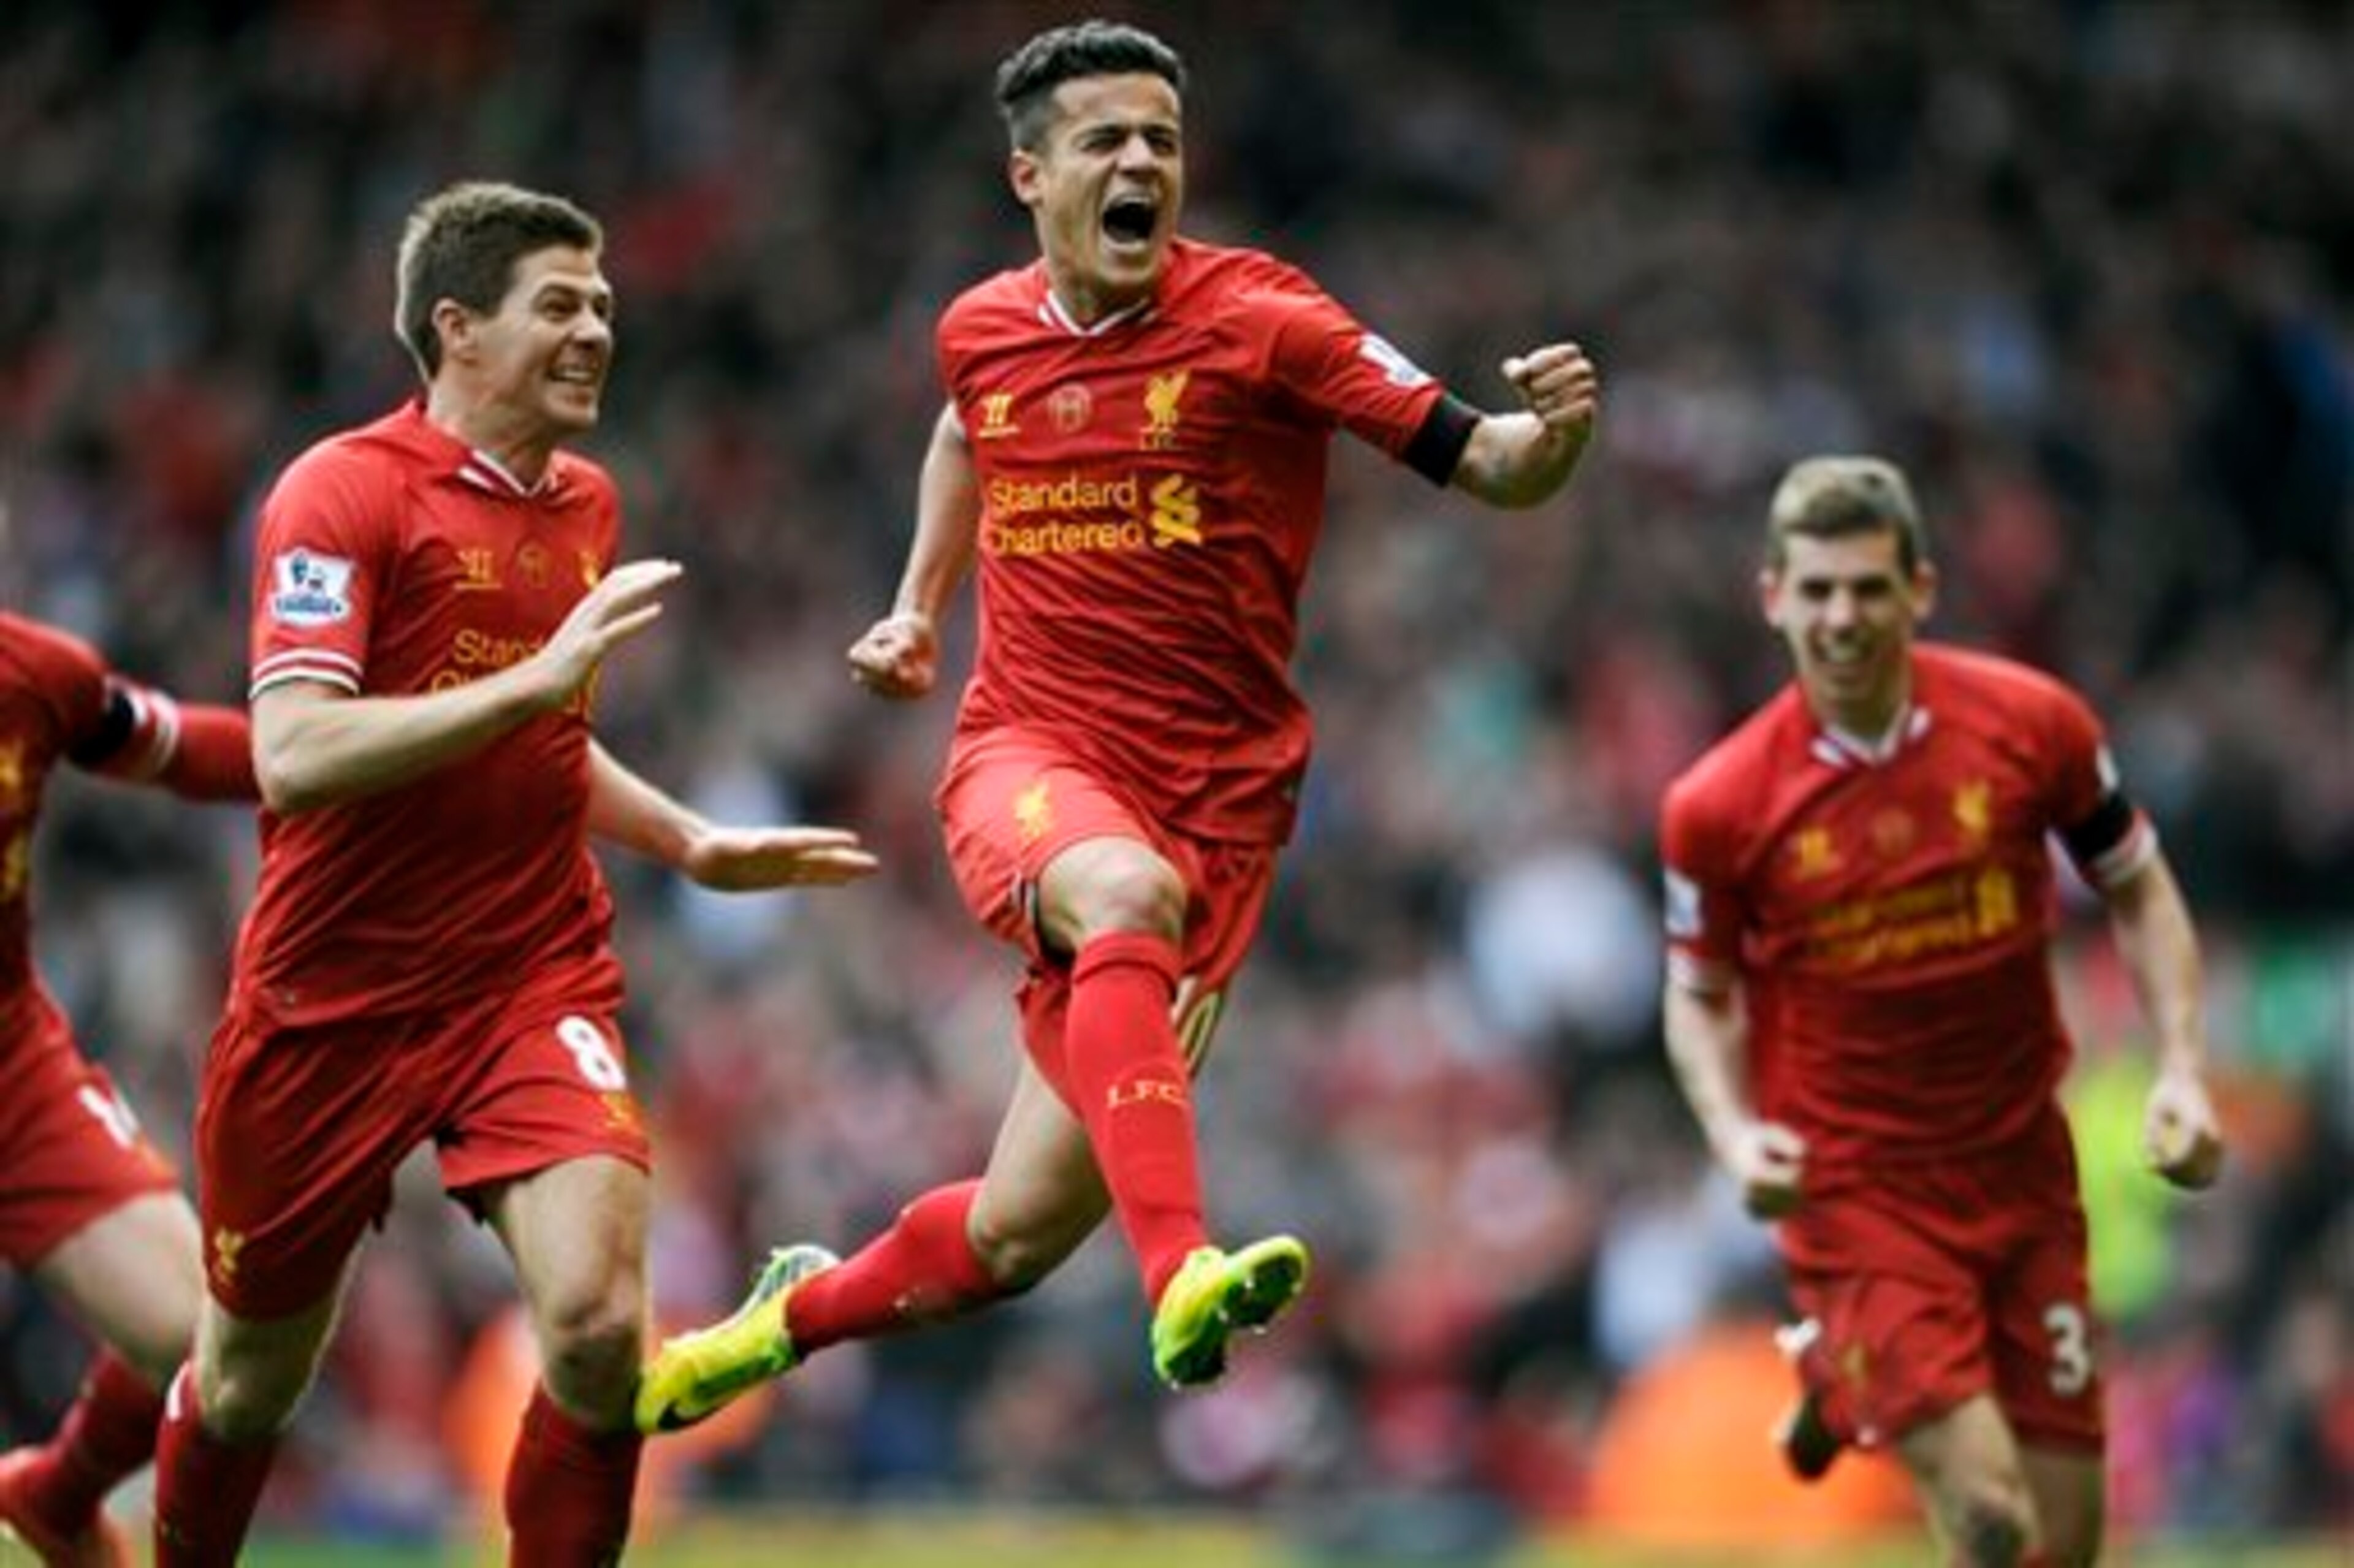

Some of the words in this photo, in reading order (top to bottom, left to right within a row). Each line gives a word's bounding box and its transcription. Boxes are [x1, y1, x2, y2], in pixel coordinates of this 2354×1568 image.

[989, 470, 1138, 516] Standard
[555, 1015, 626, 1089] 8
[2043, 1304, 2089, 1394] 3
